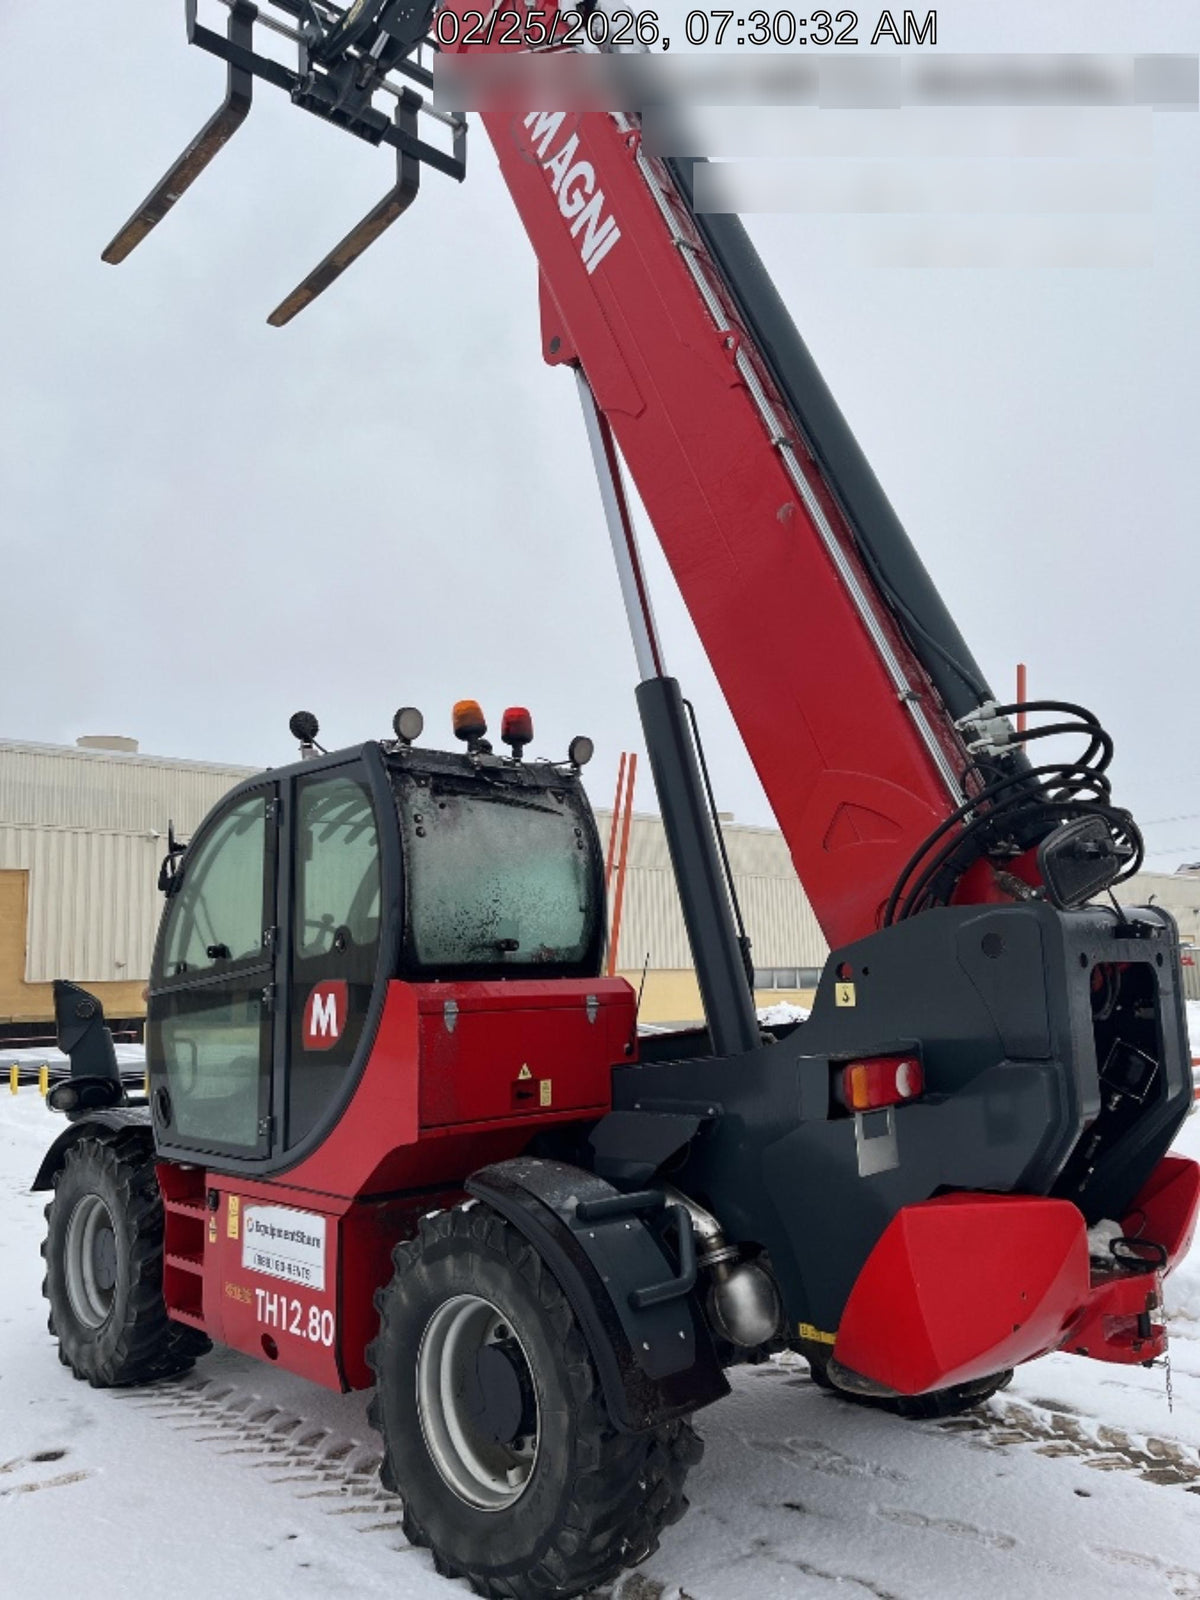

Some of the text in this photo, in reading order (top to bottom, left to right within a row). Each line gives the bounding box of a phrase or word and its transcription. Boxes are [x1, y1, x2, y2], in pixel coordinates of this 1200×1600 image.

[523, 111, 622, 275] MAGNI
[310, 993, 338, 1037] M
[255, 1287, 335, 1347] TH12.80
